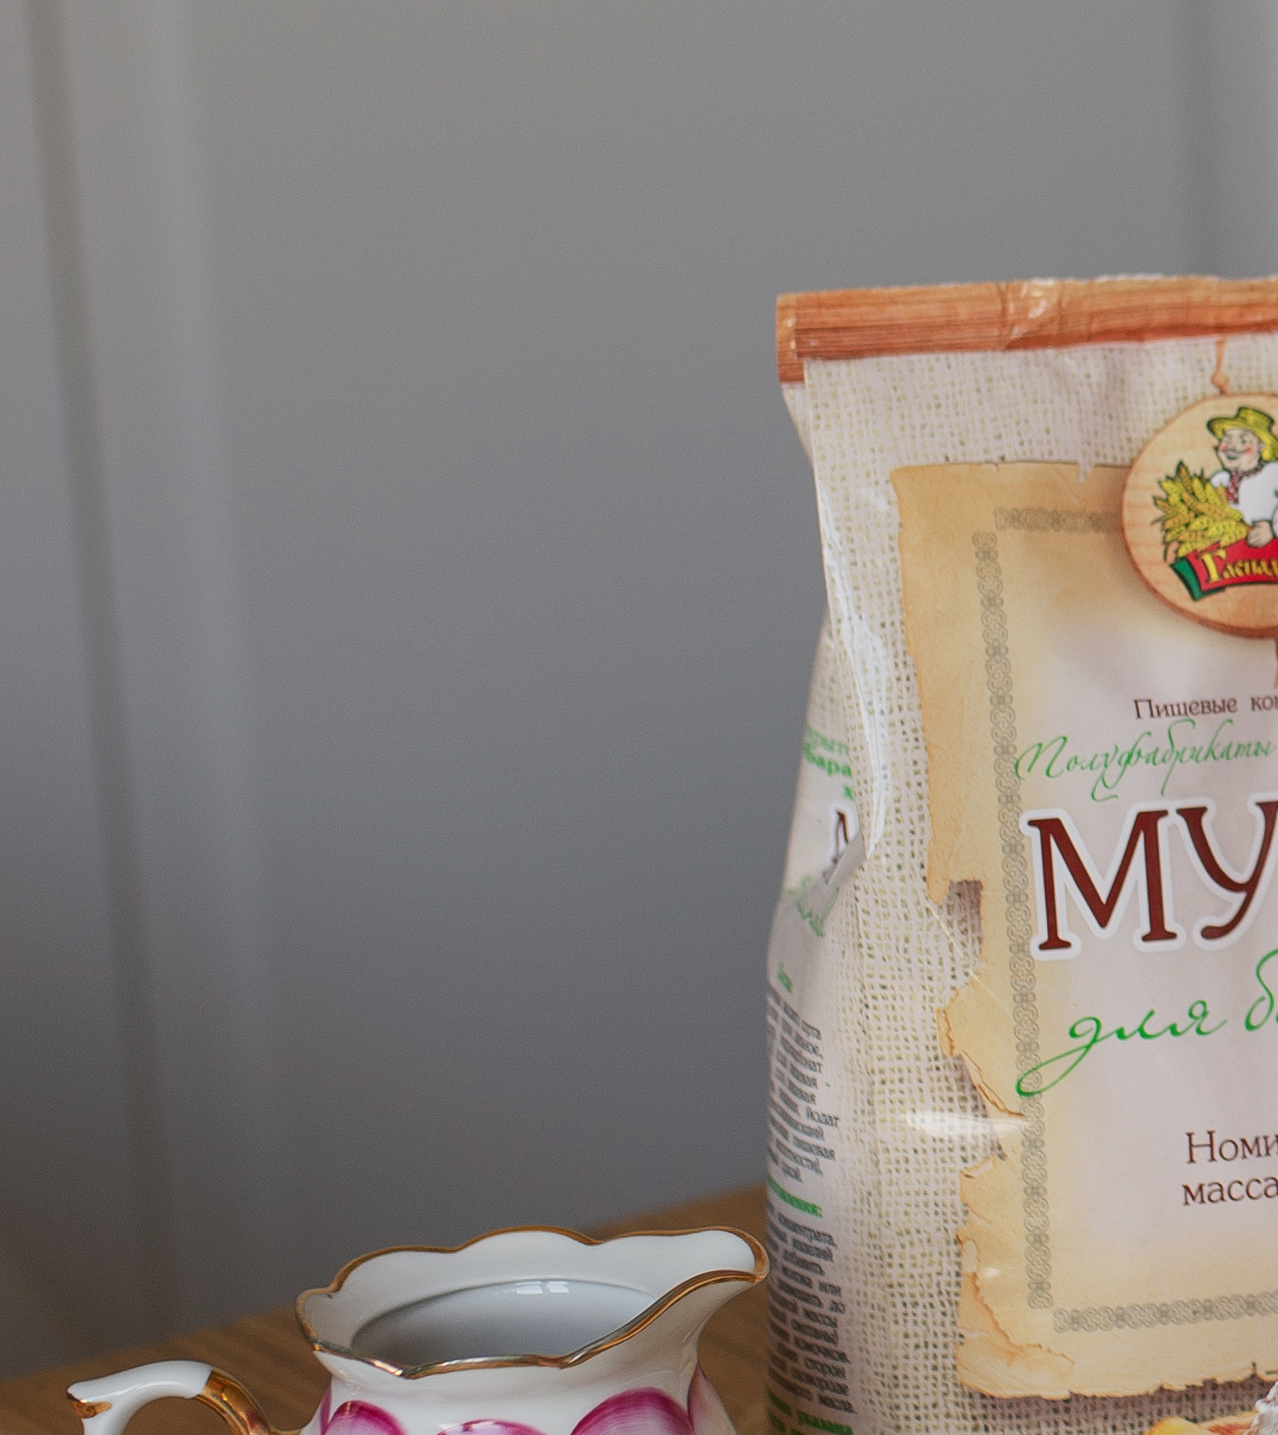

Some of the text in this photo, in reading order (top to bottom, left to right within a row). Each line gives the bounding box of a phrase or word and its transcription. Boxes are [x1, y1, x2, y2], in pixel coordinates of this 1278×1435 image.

[1133, 697, 1238, 721] Пищевые
[1015, 718, 1276, 802] Полуфабрикаты
[1015, 1000, 1228, 1097] для
